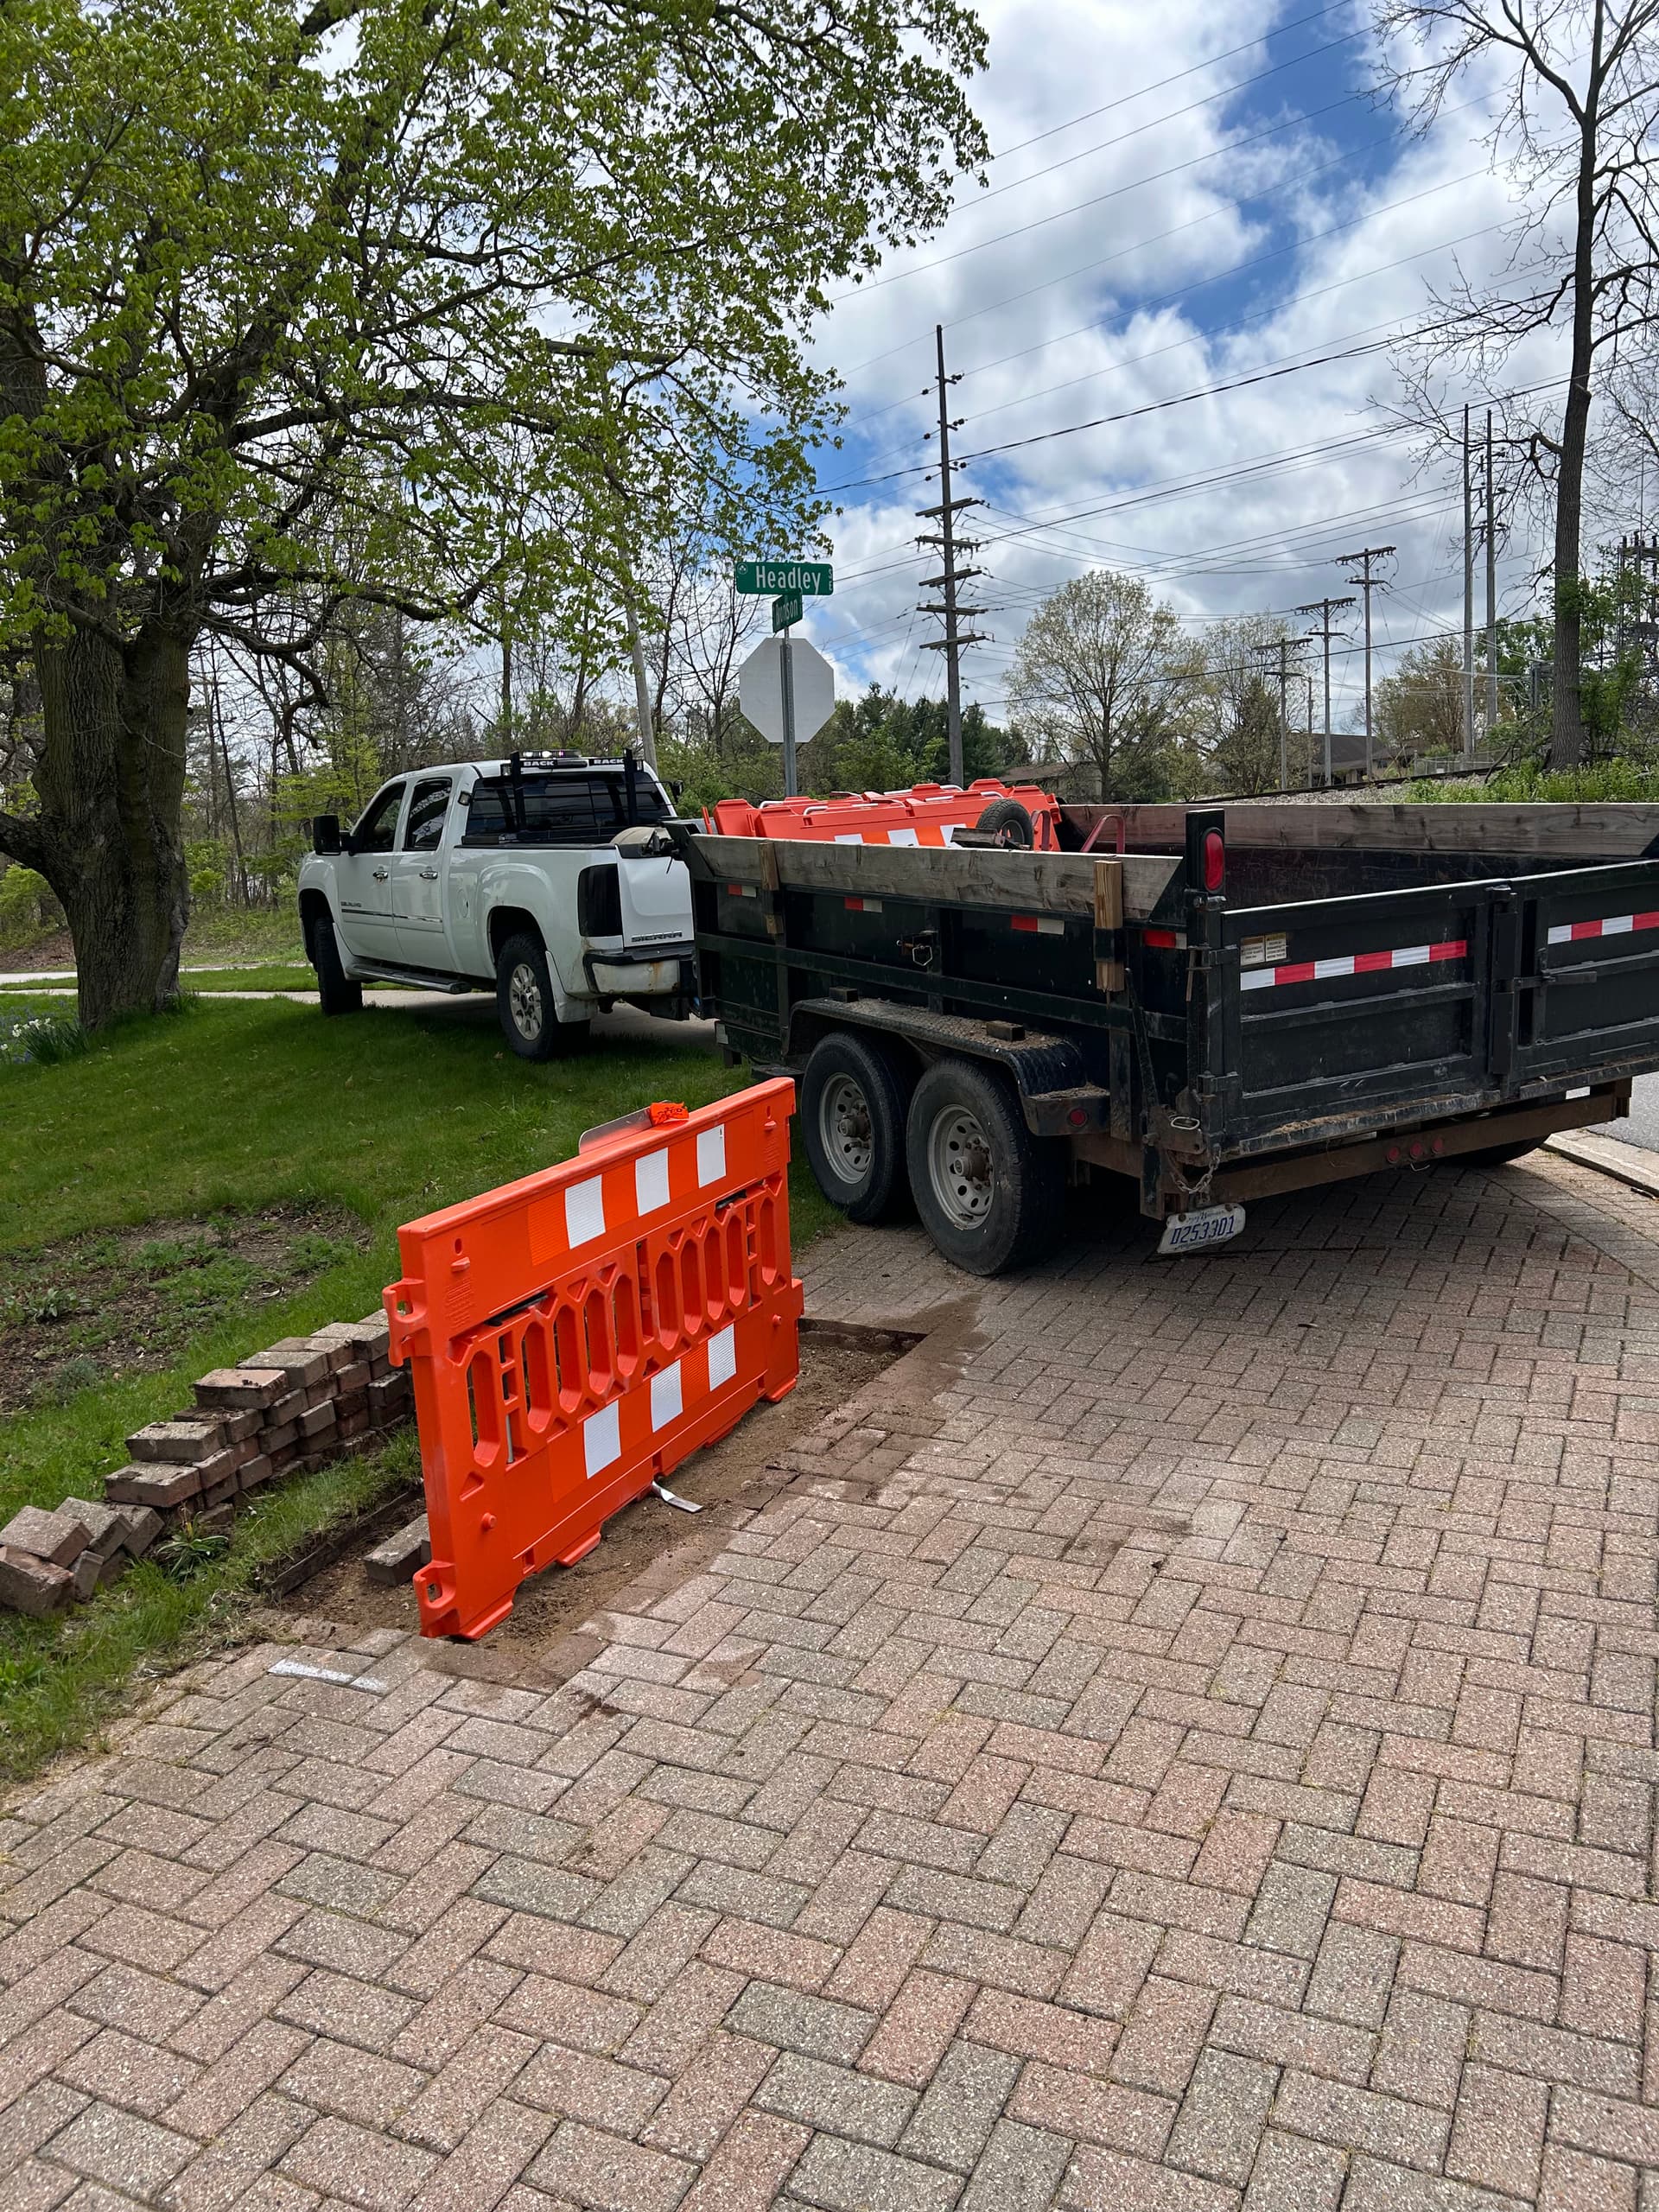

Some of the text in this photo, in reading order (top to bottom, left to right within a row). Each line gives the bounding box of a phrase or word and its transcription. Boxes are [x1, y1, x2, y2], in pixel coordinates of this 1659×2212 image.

[755, 565, 821, 594] Headley
[631, 930, 683, 942] SIERRA
[1170, 1215, 1235, 1244] D253301
